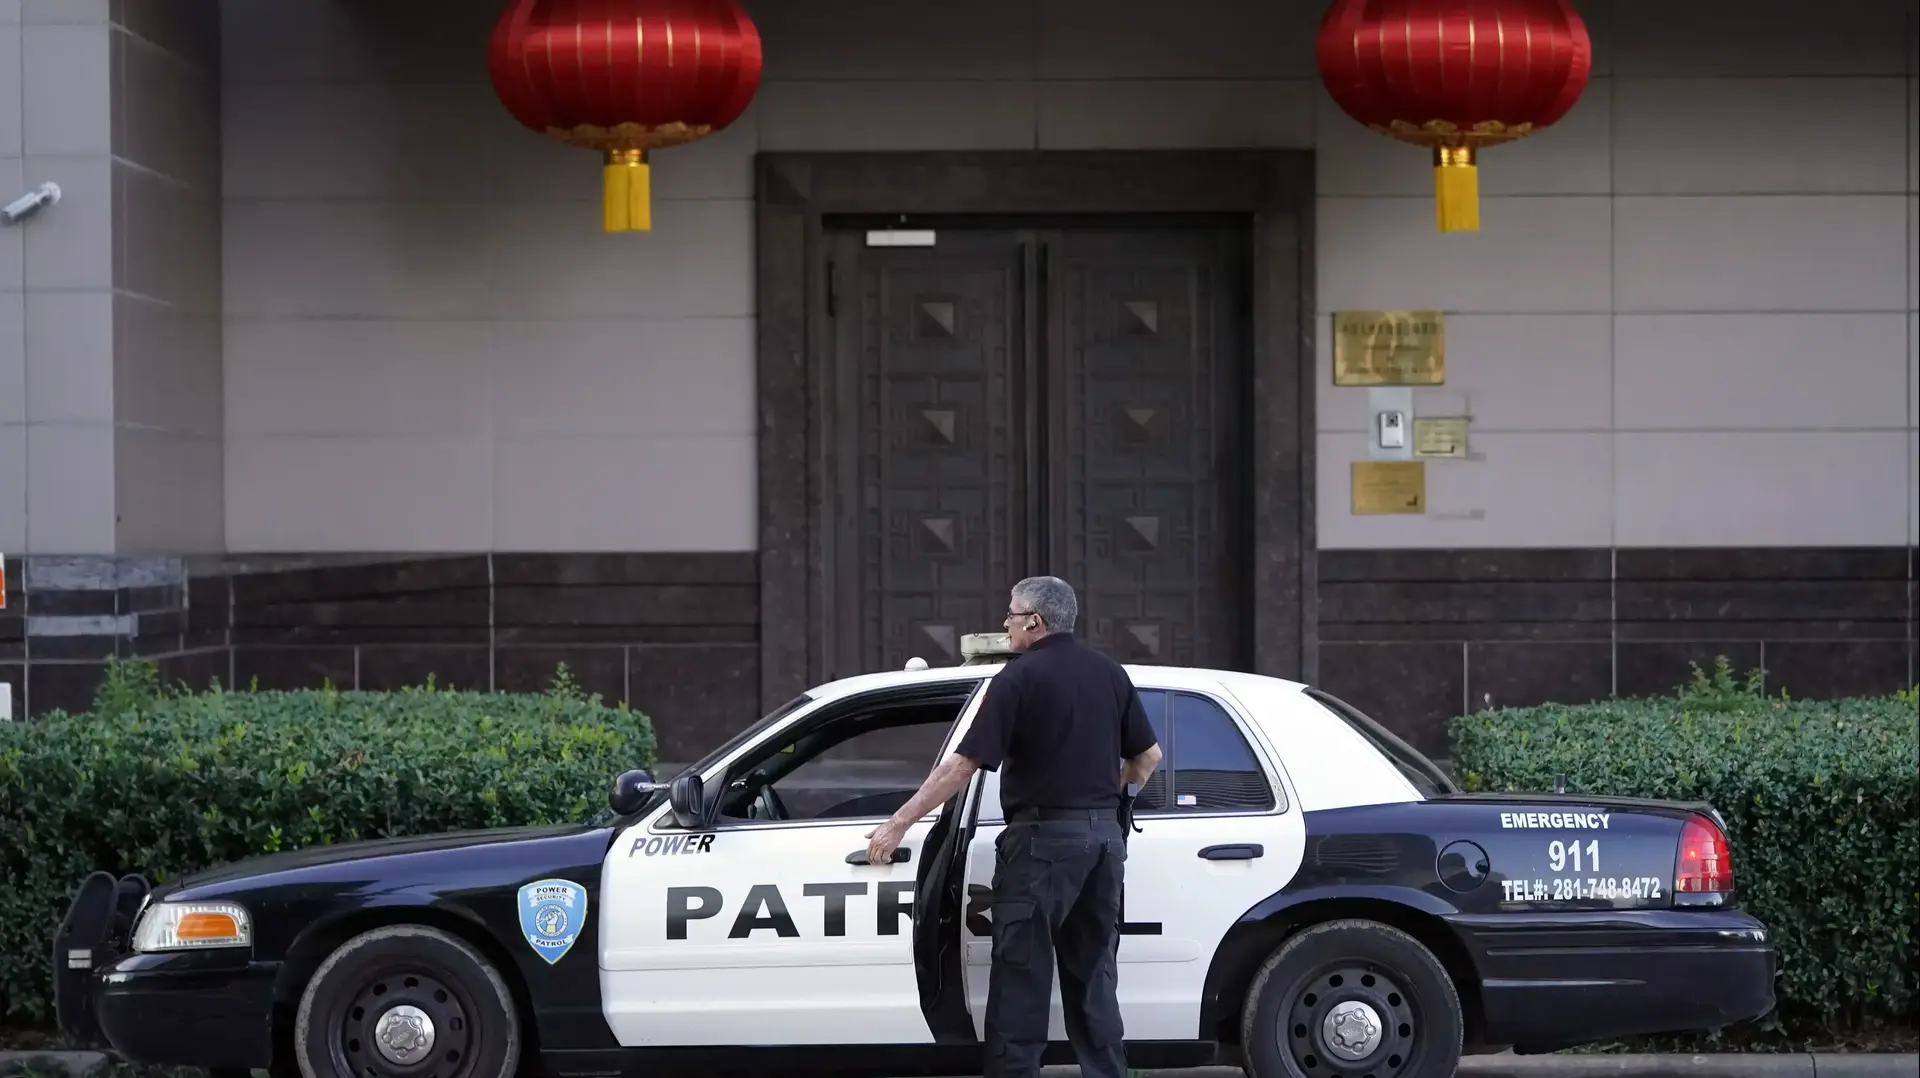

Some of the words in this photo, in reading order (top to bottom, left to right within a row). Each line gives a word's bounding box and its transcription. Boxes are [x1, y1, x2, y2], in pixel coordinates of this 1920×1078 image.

[1500, 813, 1610, 829] EMERGENCY
[628, 834, 716, 858] POWER
[1548, 839, 1600, 872] 911
[1501, 879, 1549, 901] TEL#:
[1553, 877, 1661, 900] 281-748-8472
[666, 881, 1162, 940] PATRL
[536, 939, 567, 947] PATROL
